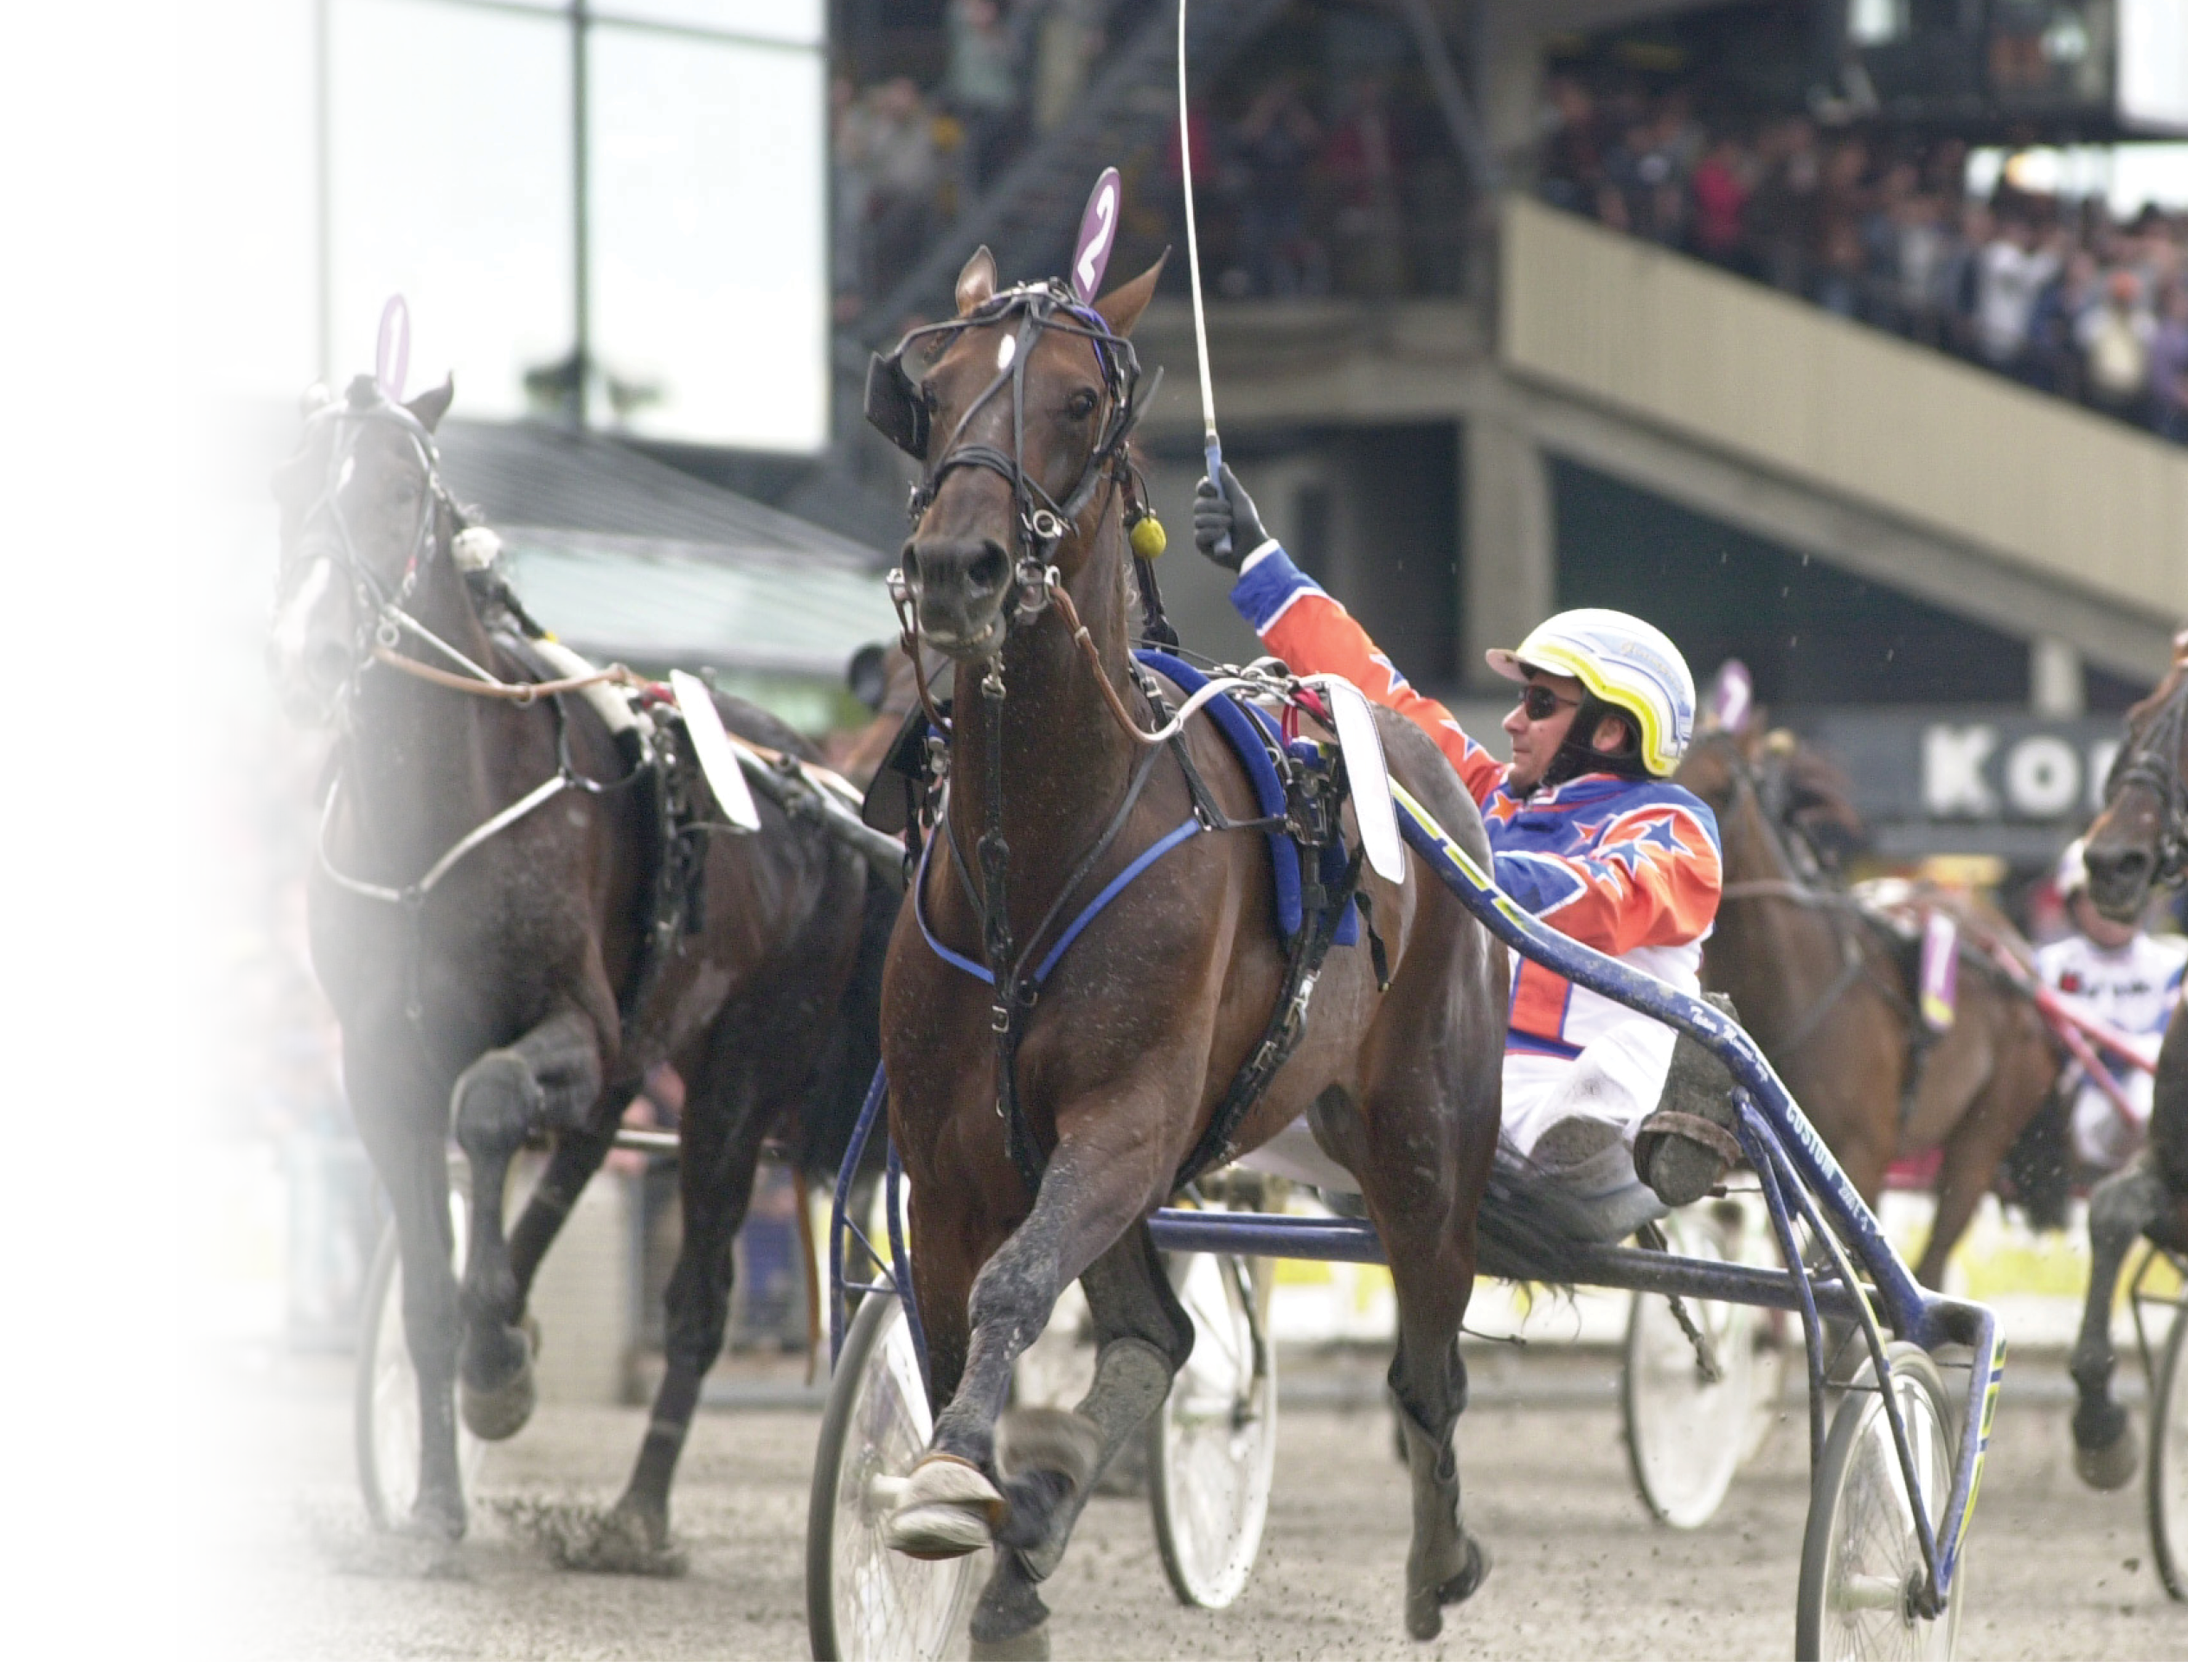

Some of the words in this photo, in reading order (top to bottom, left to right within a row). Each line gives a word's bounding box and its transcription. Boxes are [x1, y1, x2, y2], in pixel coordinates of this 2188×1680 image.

[1077, 184, 1115, 292] 2
[386, 303, 405, 386] 1
[1786, 1100, 1837, 1181] CUSTOM
